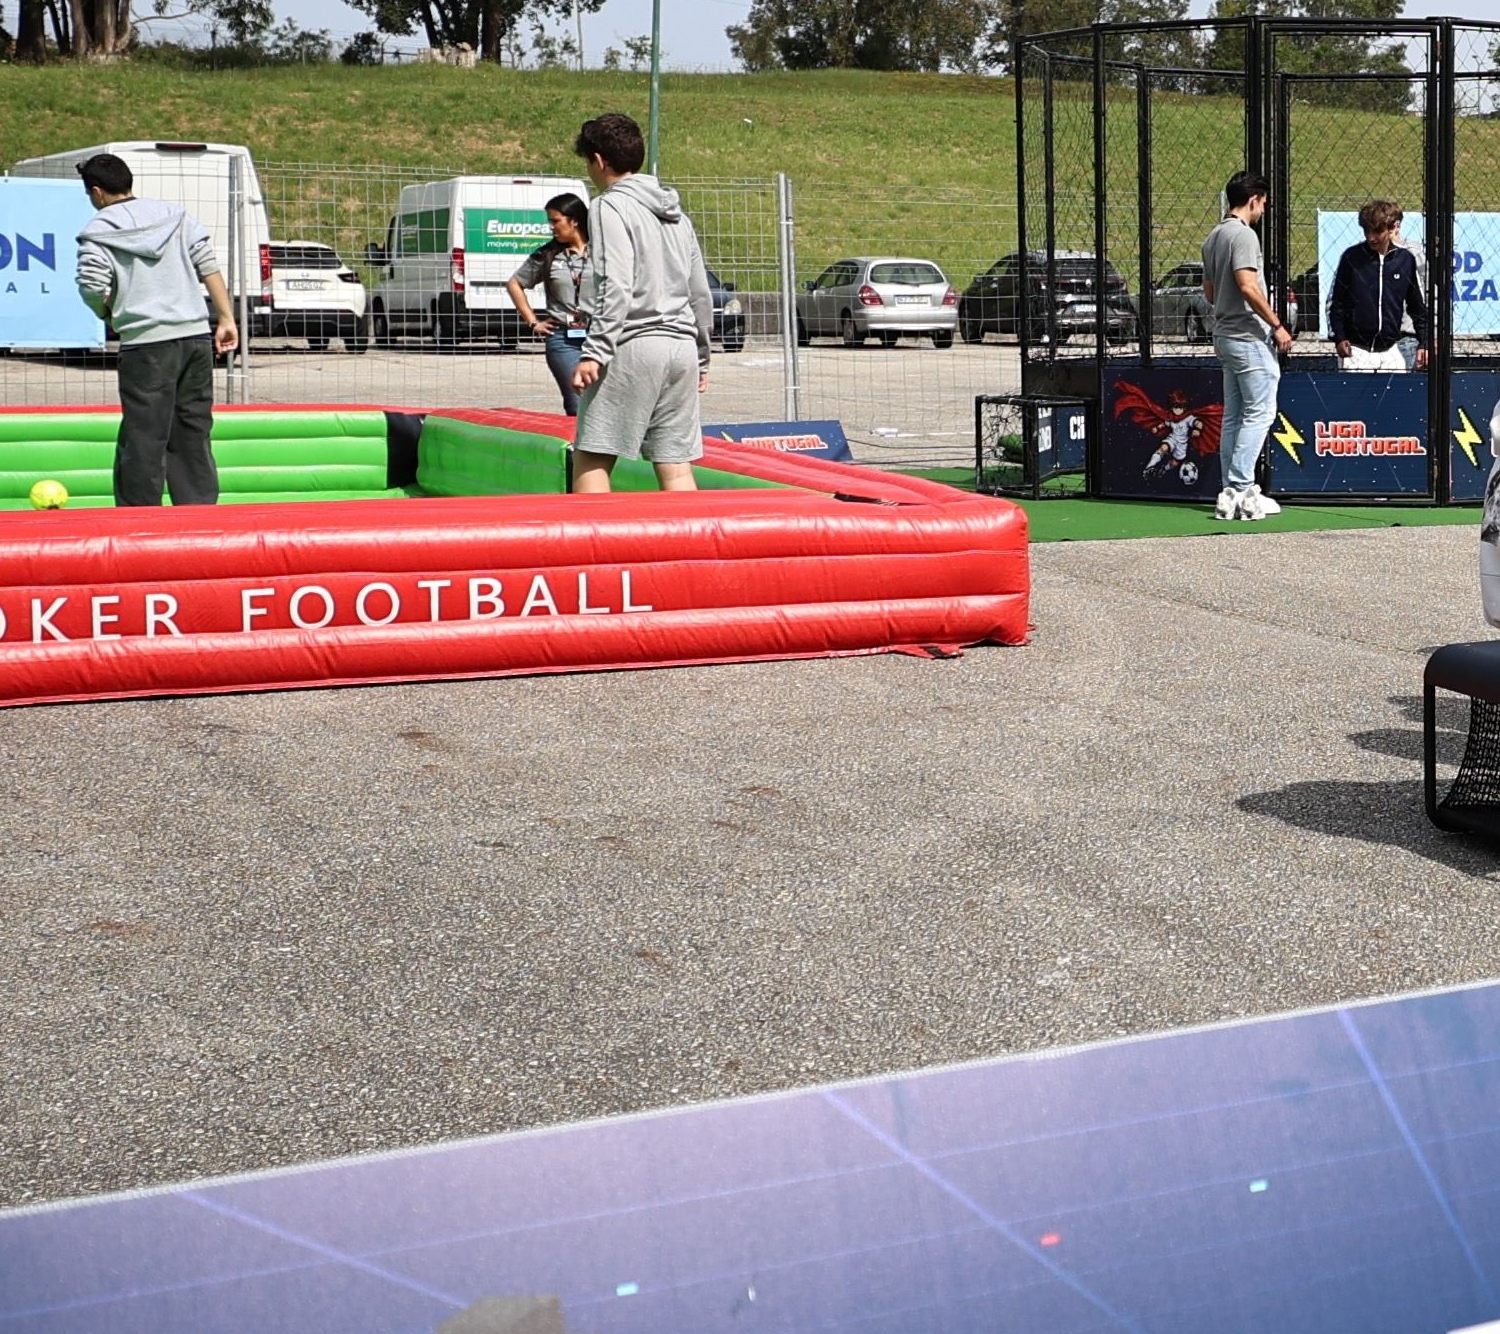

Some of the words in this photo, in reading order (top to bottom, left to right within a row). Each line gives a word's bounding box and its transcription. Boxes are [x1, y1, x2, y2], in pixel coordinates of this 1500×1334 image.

[487, 219, 553, 238] Europca
[1451, 251, 1483, 273] OD
[1314, 422, 1366, 438] LIGA
[1315, 437, 1427, 456] PORTUGAL
[241, 570, 653, 634] FOOTBALL
